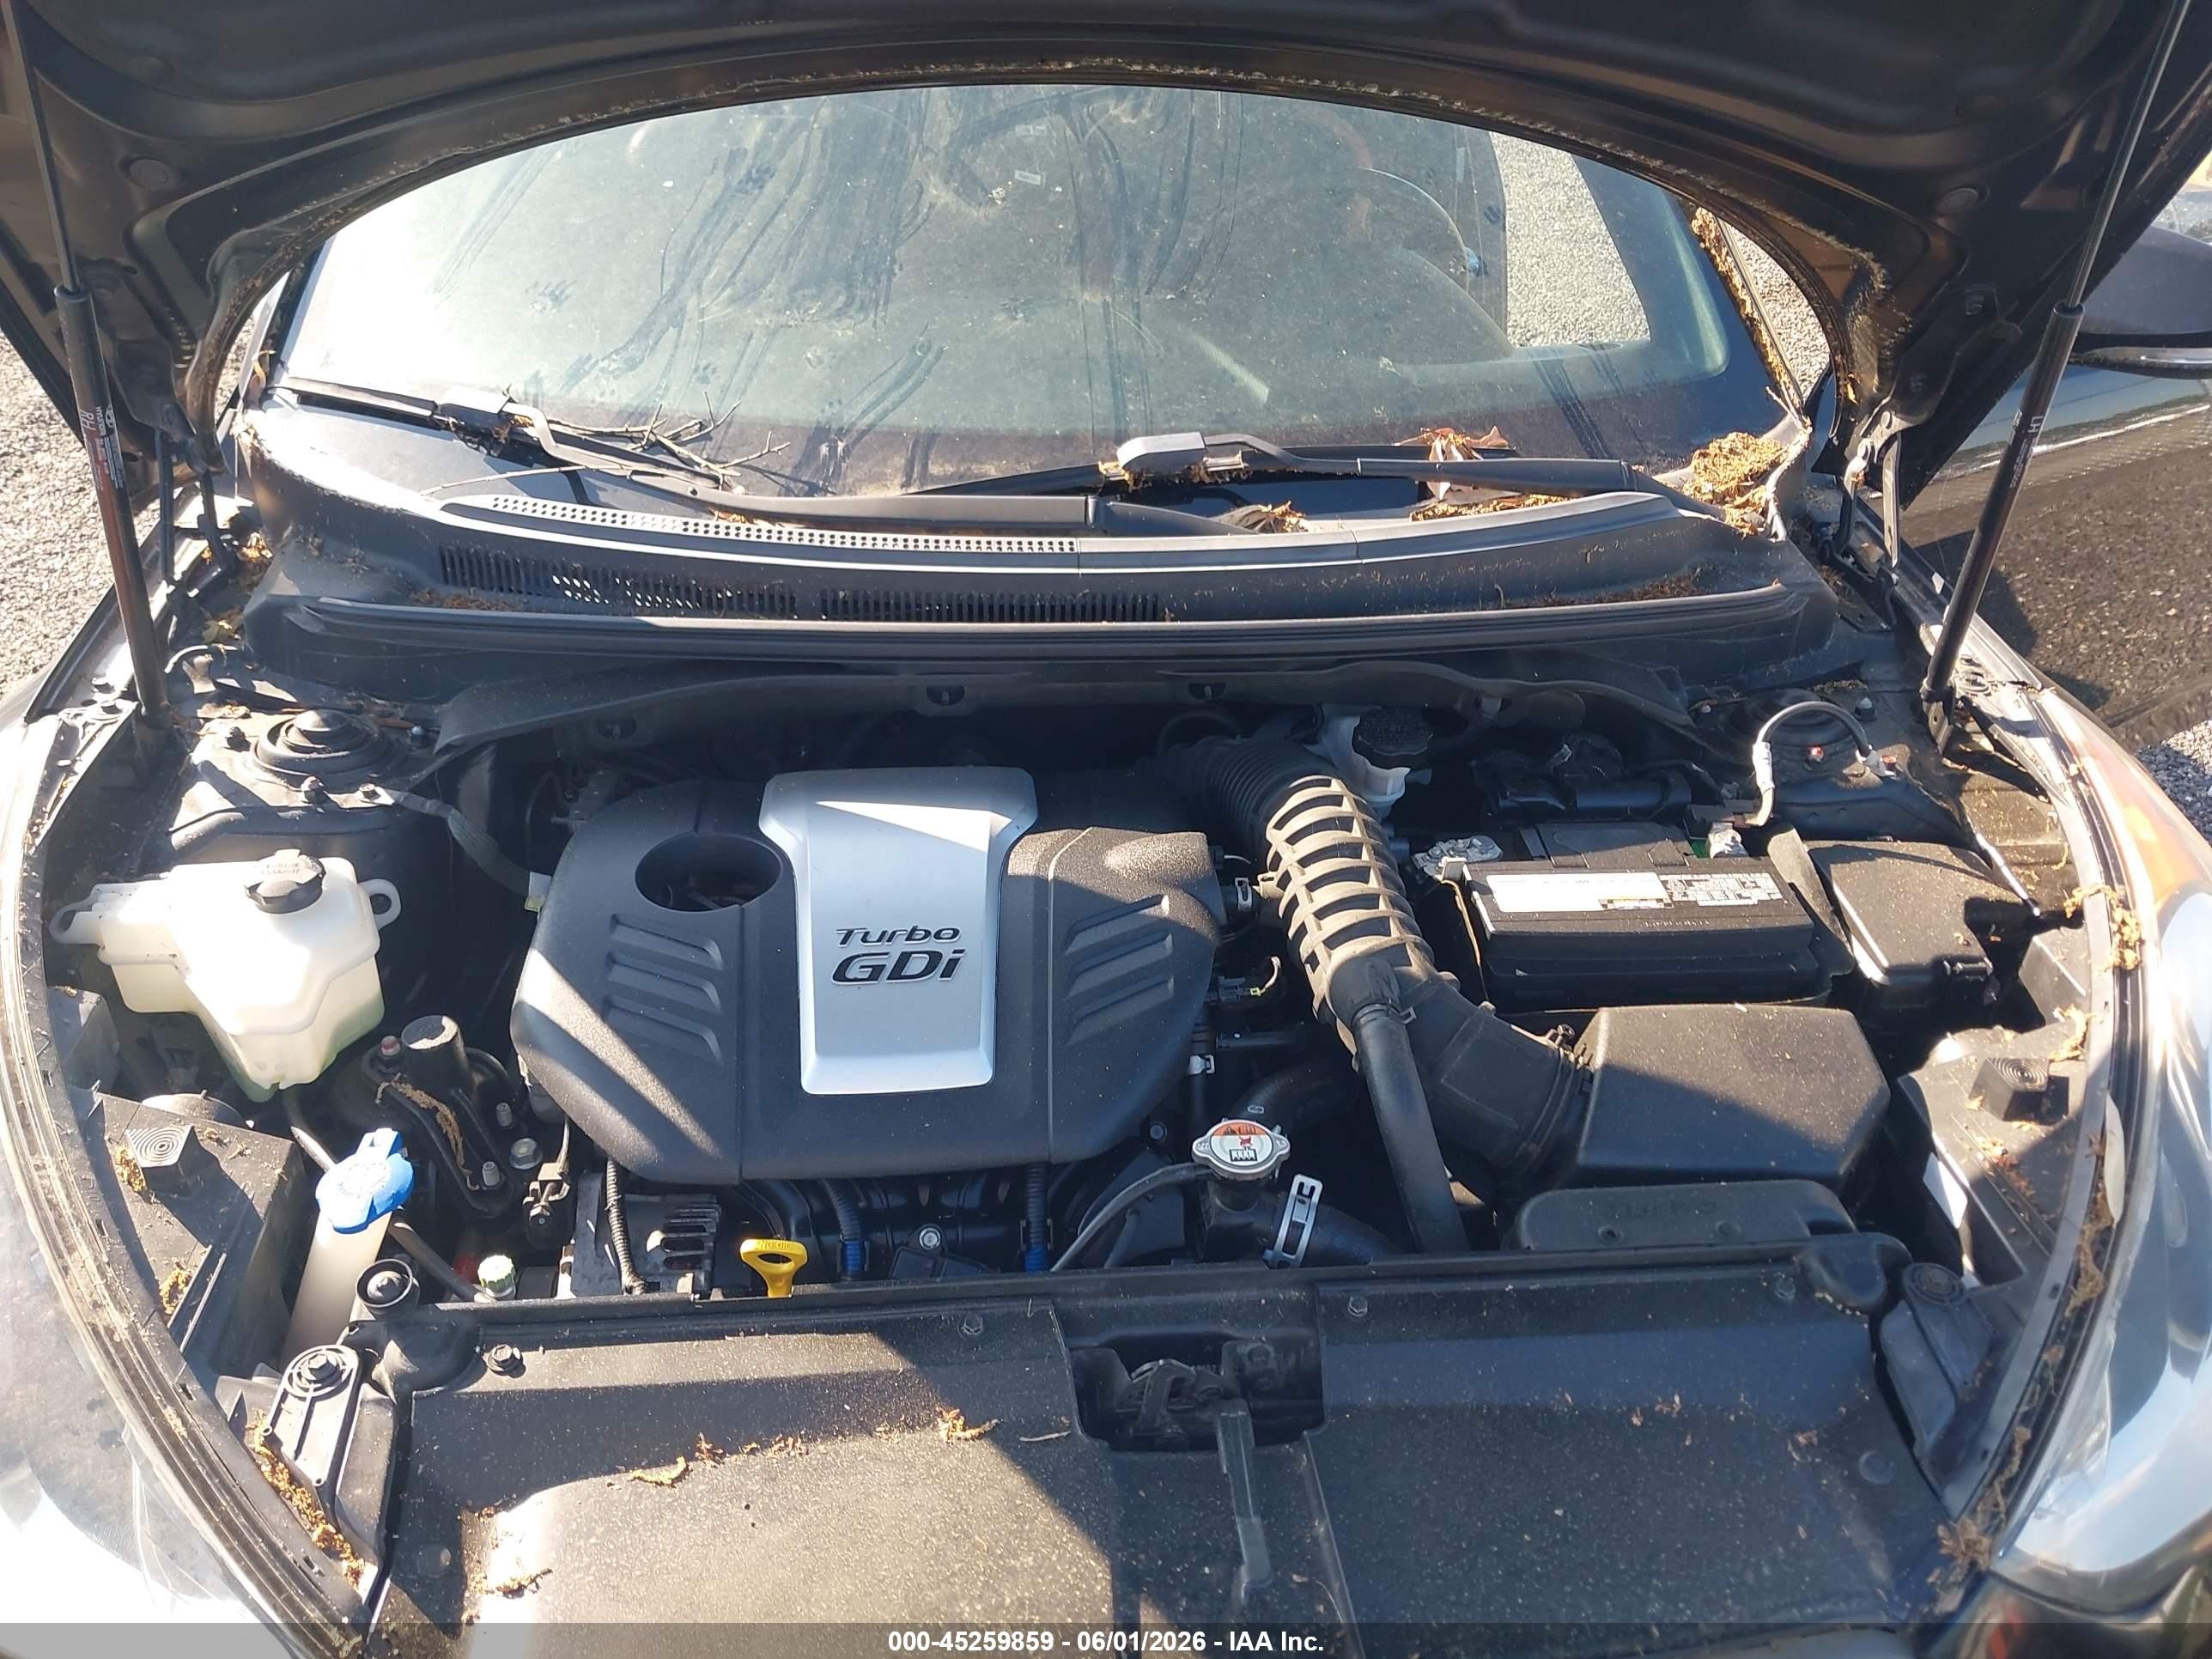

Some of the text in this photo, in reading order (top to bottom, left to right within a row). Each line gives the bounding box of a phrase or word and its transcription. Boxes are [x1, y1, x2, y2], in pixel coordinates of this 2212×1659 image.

[81, 410, 95, 431] RH
[2027, 415, 2044, 434] LH
[835, 925, 961, 947] Turbo
[832, 948, 967, 985] GDi
